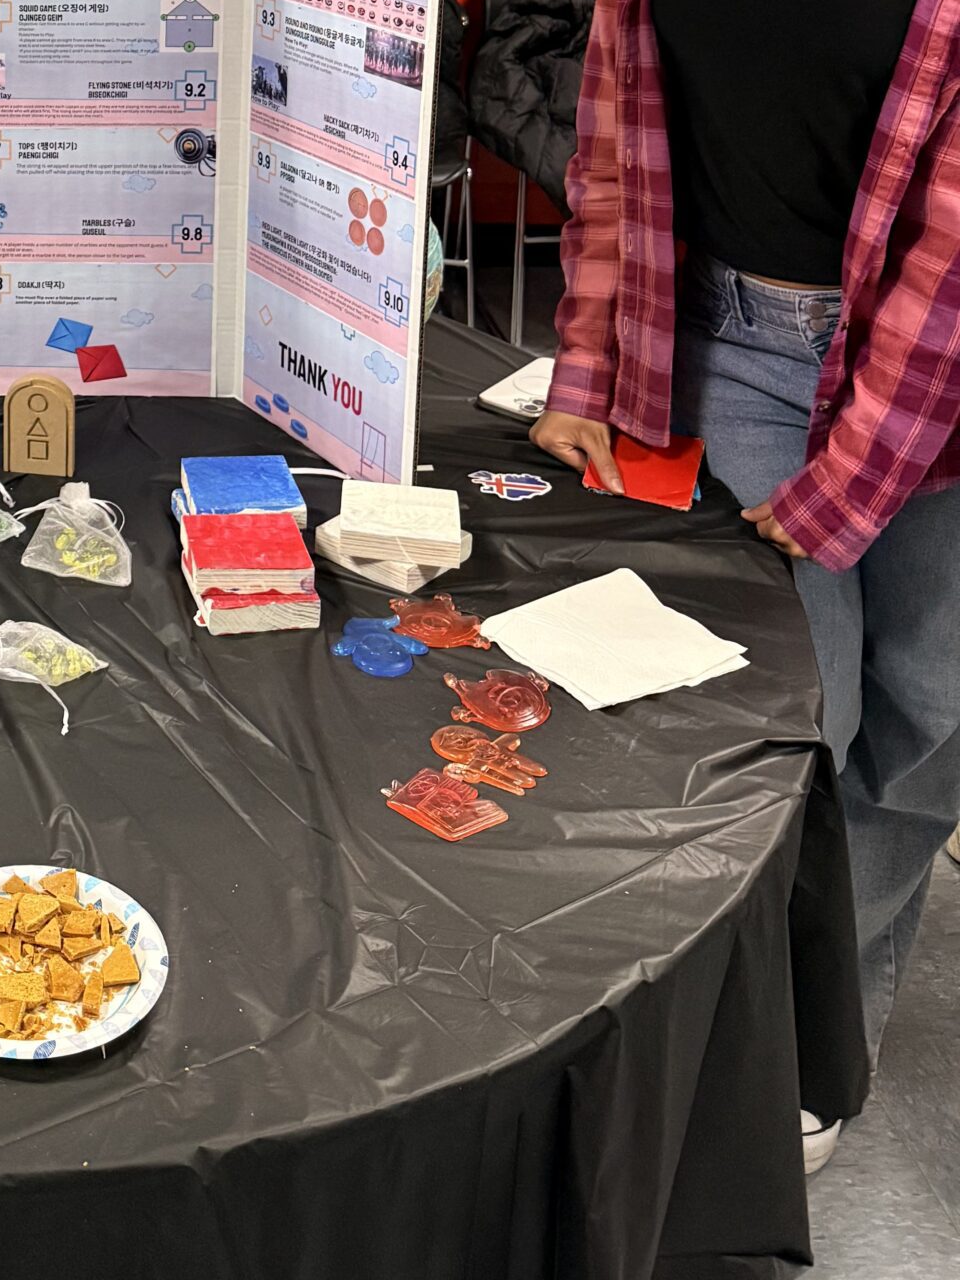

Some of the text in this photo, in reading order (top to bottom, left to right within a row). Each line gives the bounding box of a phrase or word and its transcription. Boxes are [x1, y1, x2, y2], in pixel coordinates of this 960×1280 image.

[19, 4, 38, 12] SQUID
[40, 4, 56, 12] GAME
[262, 10, 275, 26] 9.3
[285, 16, 299, 28] ROUND
[300, 21, 308, 30] AND
[309, 23, 323, 34] ROUND
[89, 82, 109, 90] FLYING
[185, 83, 206, 96] 9.2
[258, 152, 270, 169] 9.9
[392, 151, 408, 170] 9.4
[182, 228, 202, 240] 9.8
[384, 291, 403, 312] 9.10
[279, 341, 362, 416] THANK YOU
